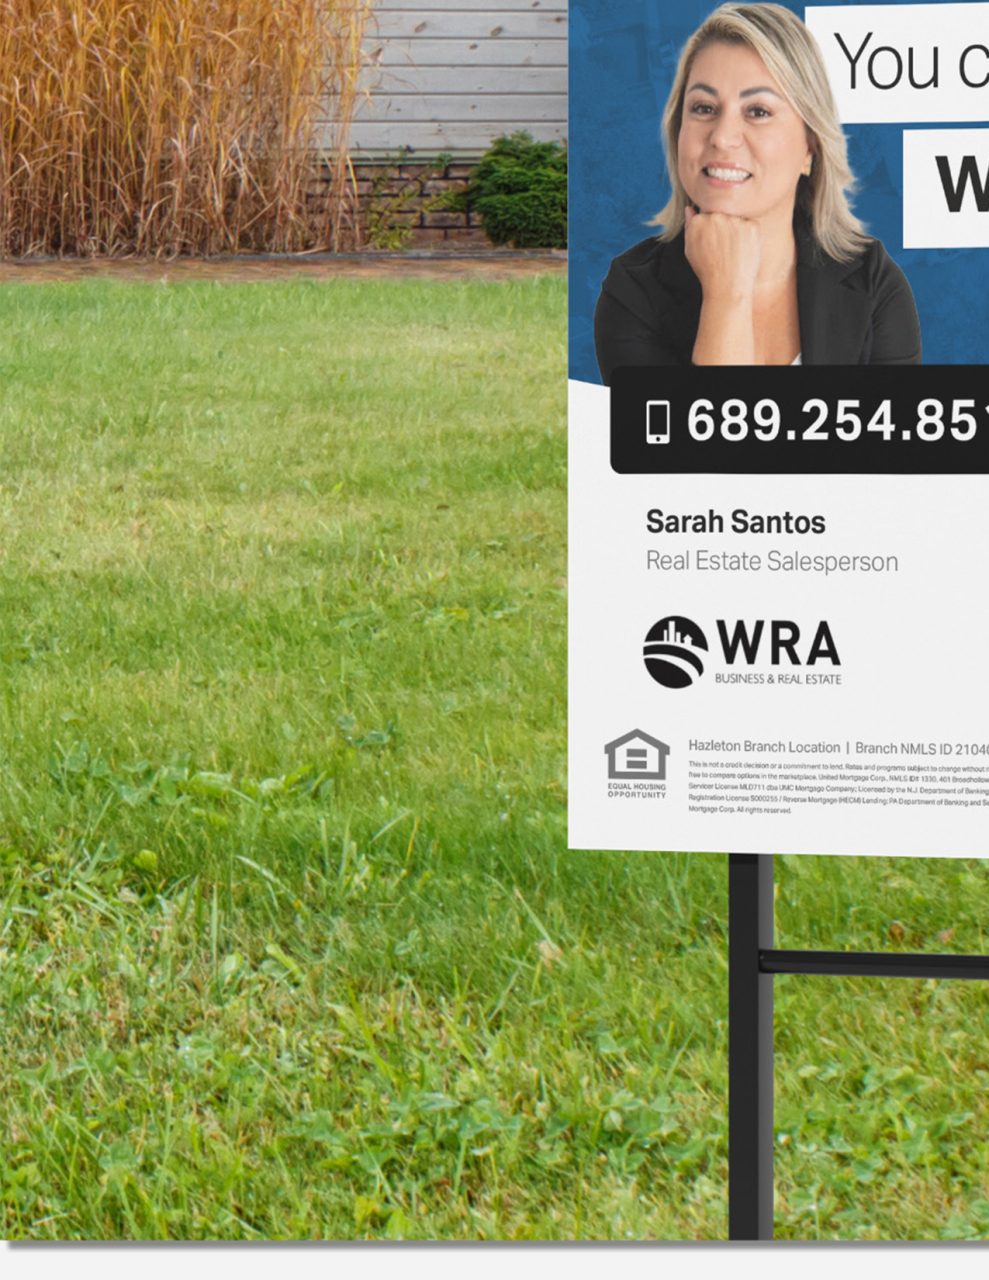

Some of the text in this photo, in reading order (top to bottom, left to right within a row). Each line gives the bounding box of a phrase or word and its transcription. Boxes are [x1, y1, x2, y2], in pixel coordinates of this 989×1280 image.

[834, 32, 938, 90] You
[647, 509, 825, 534] Sarah Santos
[647, 550, 898, 576] Real Estate Salesperson
[716, 620, 841, 665] WRA
[715, 673, 841, 685] BUSINESS & REAL ESTATE
[689, 740, 740, 751] Hazleton
[744, 740, 785, 752] Branch
[789, 741, 840, 753] Location
[856, 742, 897, 754] Branch
[901, 743, 936, 755] NMLS
[940, 743, 952, 755] ID
